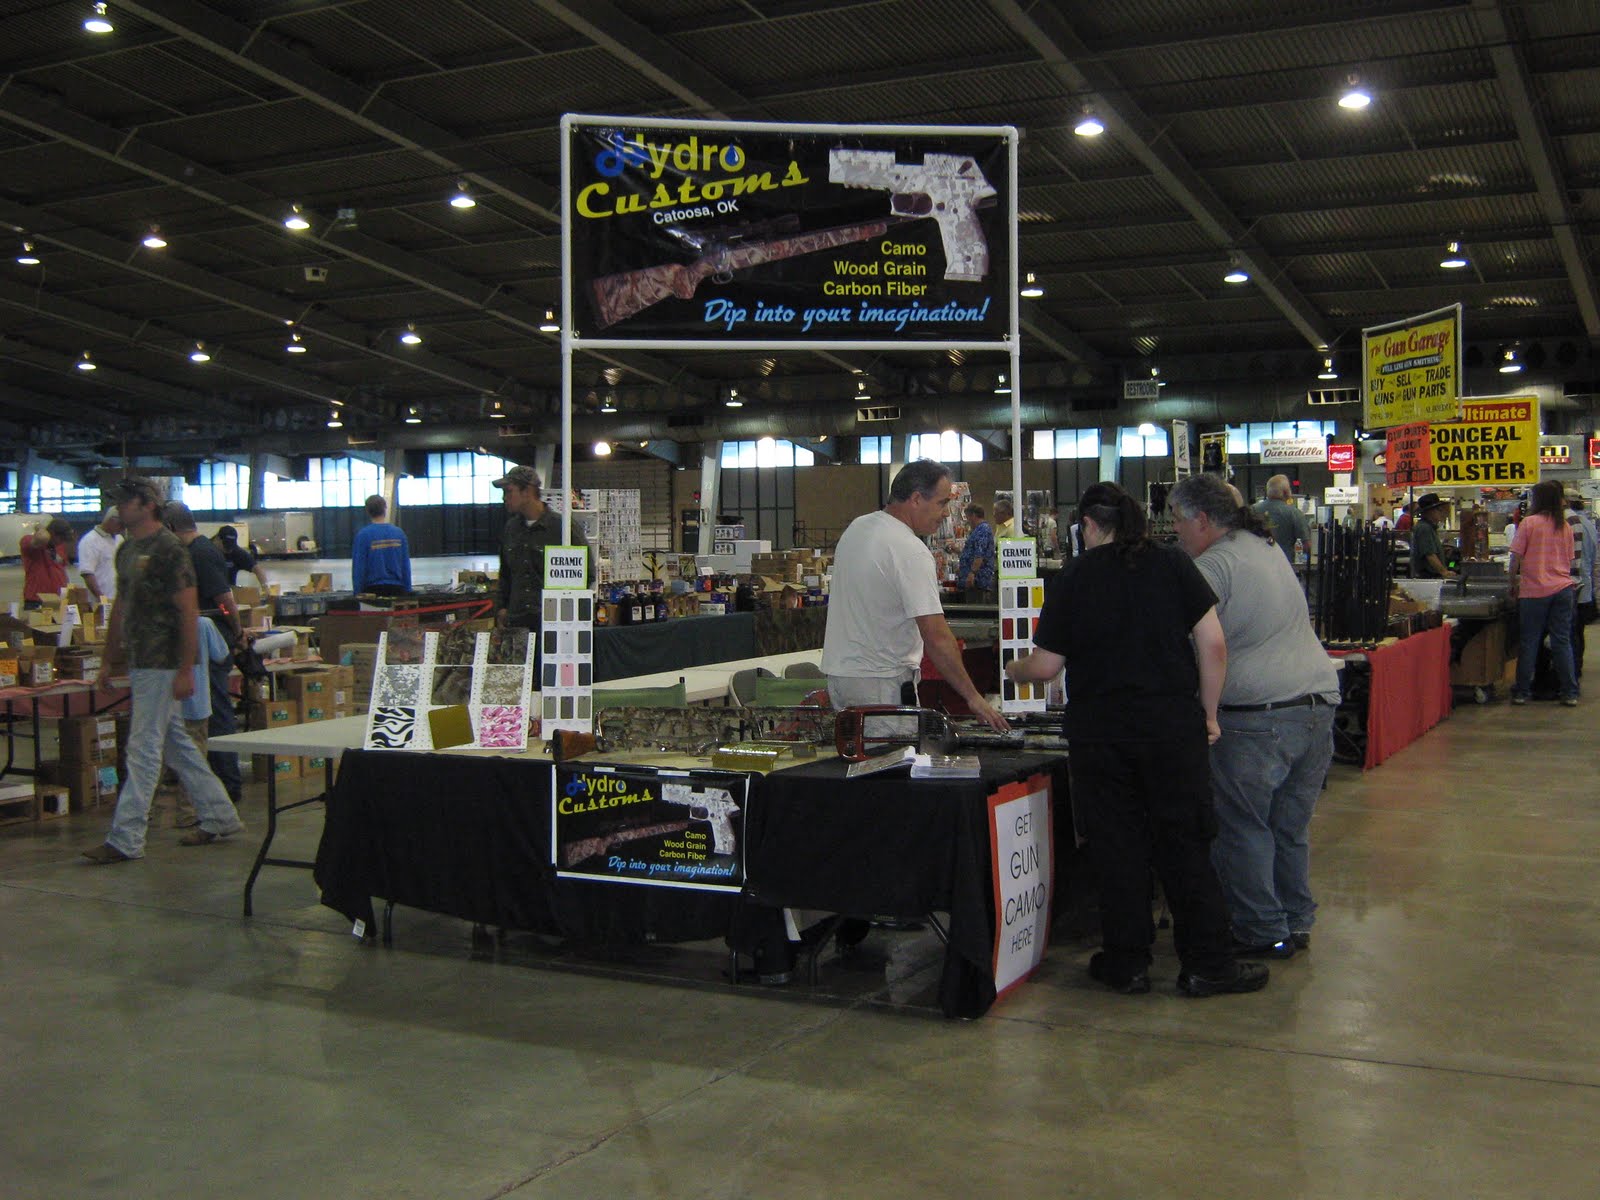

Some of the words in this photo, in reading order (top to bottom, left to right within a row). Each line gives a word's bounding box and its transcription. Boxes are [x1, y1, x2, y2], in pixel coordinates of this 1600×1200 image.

[596, 132, 745, 179] Hydro
[576, 160, 809, 218] Customs
[653, 205, 715, 225] Catoosa,
[717, 200, 740, 213] OK
[881, 241, 927, 256] Camo
[833, 261, 879, 276] Wood
[883, 261, 927, 276] Grain
[823, 281, 882, 296] Carbon
[886, 281, 928, 296] Fiber
[704, 299, 746, 331] Dip
[754, 302, 796, 323] into
[801, 306, 852, 332] your
[858, 297, 991, 332] imagination!
[1384, 336, 1406, 358] Gun
[1407, 331, 1451, 354] Garage
[1370, 379, 1385, 391] BUY
[1396, 373, 1411, 387] SELL
[1425, 365, 1451, 382] TRADE
[1374, 392, 1394, 405] GUNS
[1403, 387, 1416, 402] GUN
[1419, 382, 1446, 399] PARTS
[1264, 447, 1323, 458] Quesadilla
[1437, 444, 1509, 461] CARRY
[550, 557, 583, 567] CERAMIC
[1002, 548, 1032, 558] CERAMIC
[1002, 559, 1032, 569] COATING
[549, 569, 583, 579] COATING
[565, 773, 627, 796] Hydro
[558, 788, 654, 815] Customs
[685, 831, 707, 840] Camo
[1014, 812, 1033, 837] GET
[659, 850, 687, 859] Carbon
[688, 851, 707, 860] Fiber
[664, 840, 688, 850] Wood
[689, 841, 707, 850] Grain
[608, 856, 627, 870] Dip
[629, 858, 647, 870] into
[649, 861, 671, 875] your
[674, 862, 736, 878] imagination!
[1010, 843, 1039, 880] GUN
[1005, 882, 1046, 926] CAMO
[1011, 925, 1034, 954] HERE
